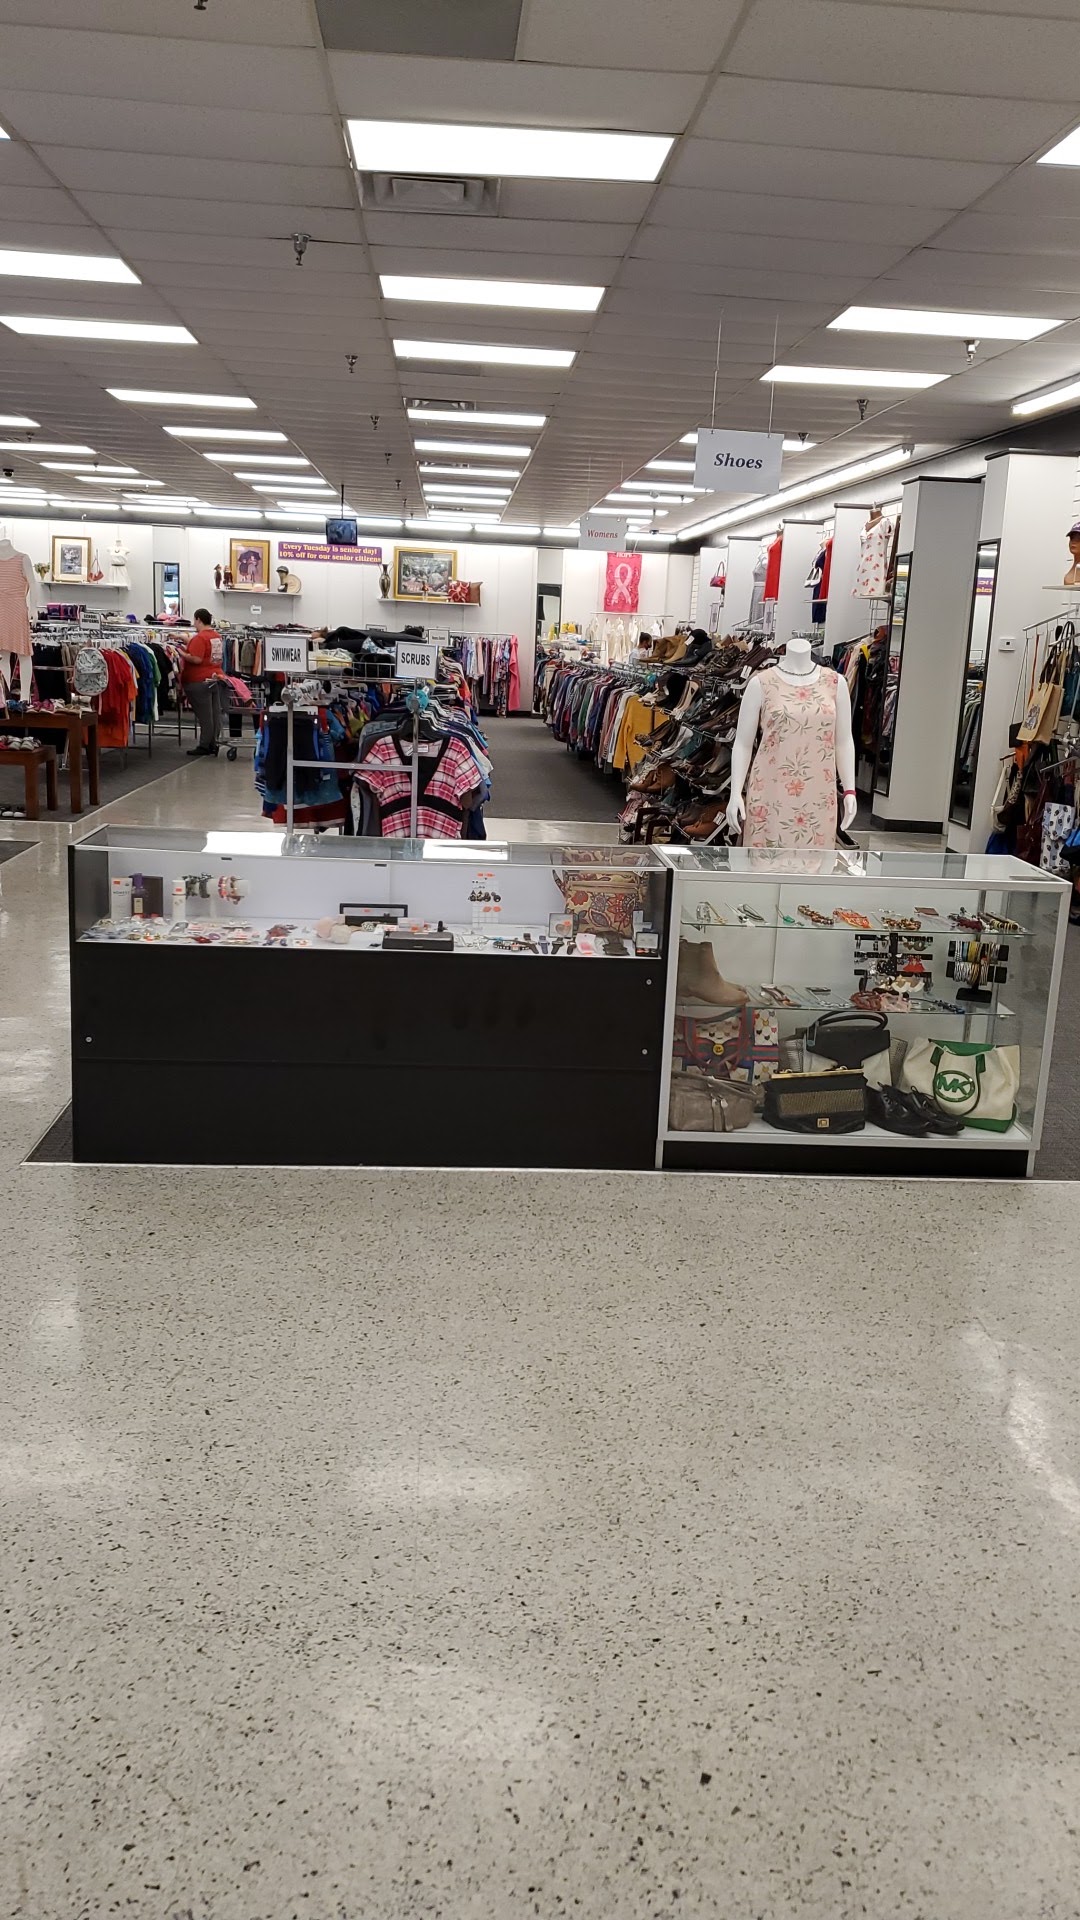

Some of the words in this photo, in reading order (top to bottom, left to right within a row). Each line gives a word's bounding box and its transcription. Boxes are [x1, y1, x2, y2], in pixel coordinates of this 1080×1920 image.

[713, 452, 763, 470] Shoes
[586, 529, 619, 539] Womens
[279, 550, 294, 558] 10%
[295, 551, 306, 559] off
[354, 555, 382, 563] citizens
[283, 543, 302, 551] Every
[303, 544, 331, 553] Tuesday
[339, 546, 361, 554] senior
[362, 547, 378, 555] day!
[271, 646, 302, 664] SWIMWEAR
[400, 651, 431, 667] SCRUBS
[936, 1073, 970, 1097] MK
